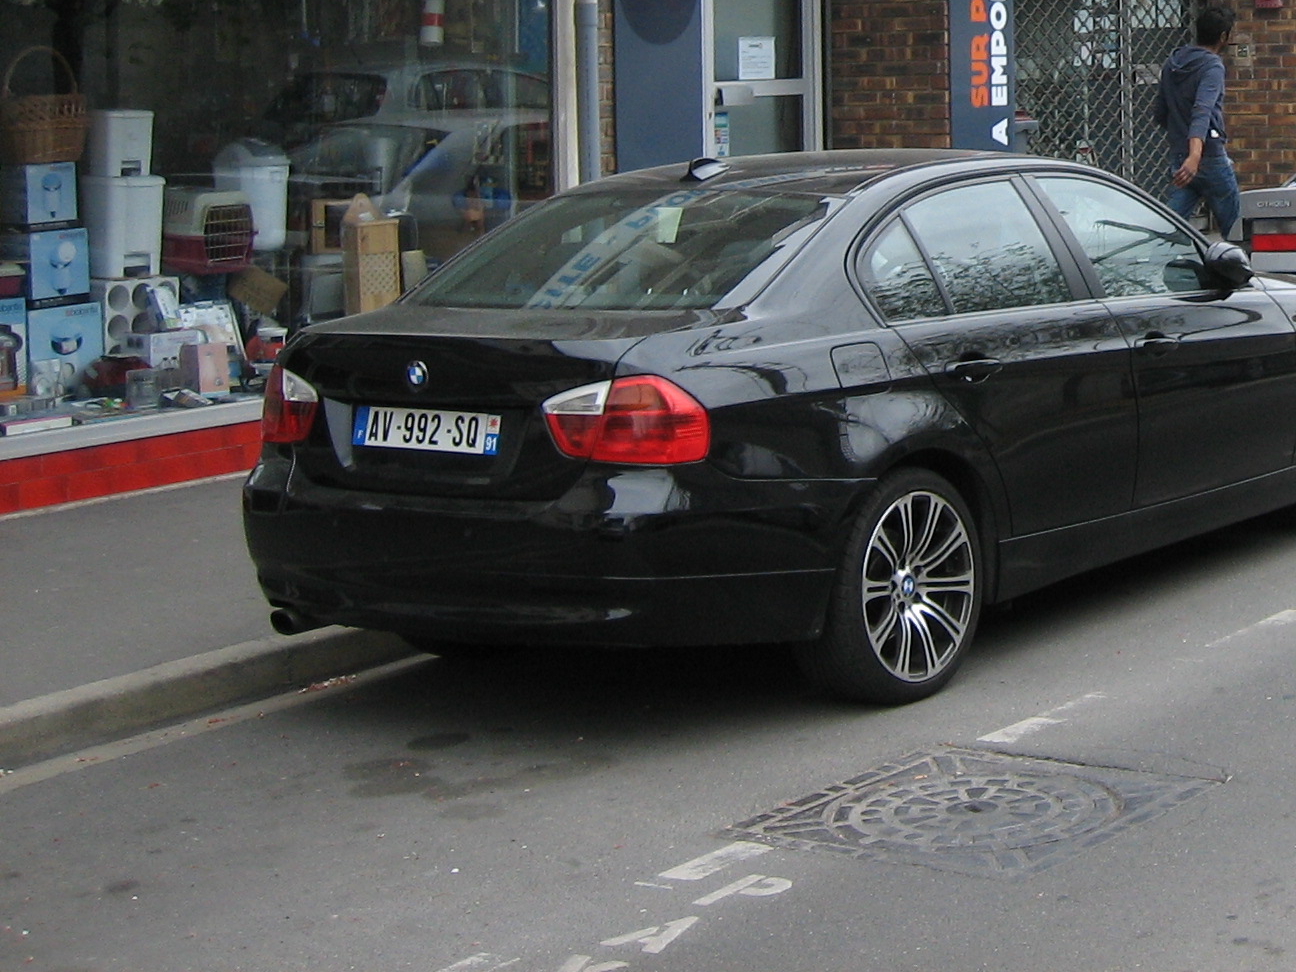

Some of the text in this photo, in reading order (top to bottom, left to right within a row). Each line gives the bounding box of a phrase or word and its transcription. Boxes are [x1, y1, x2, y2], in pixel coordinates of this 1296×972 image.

[970, 33, 990, 108] SUR
[991, 117, 1009, 146] A
[485, 436, 498, 452] 91
